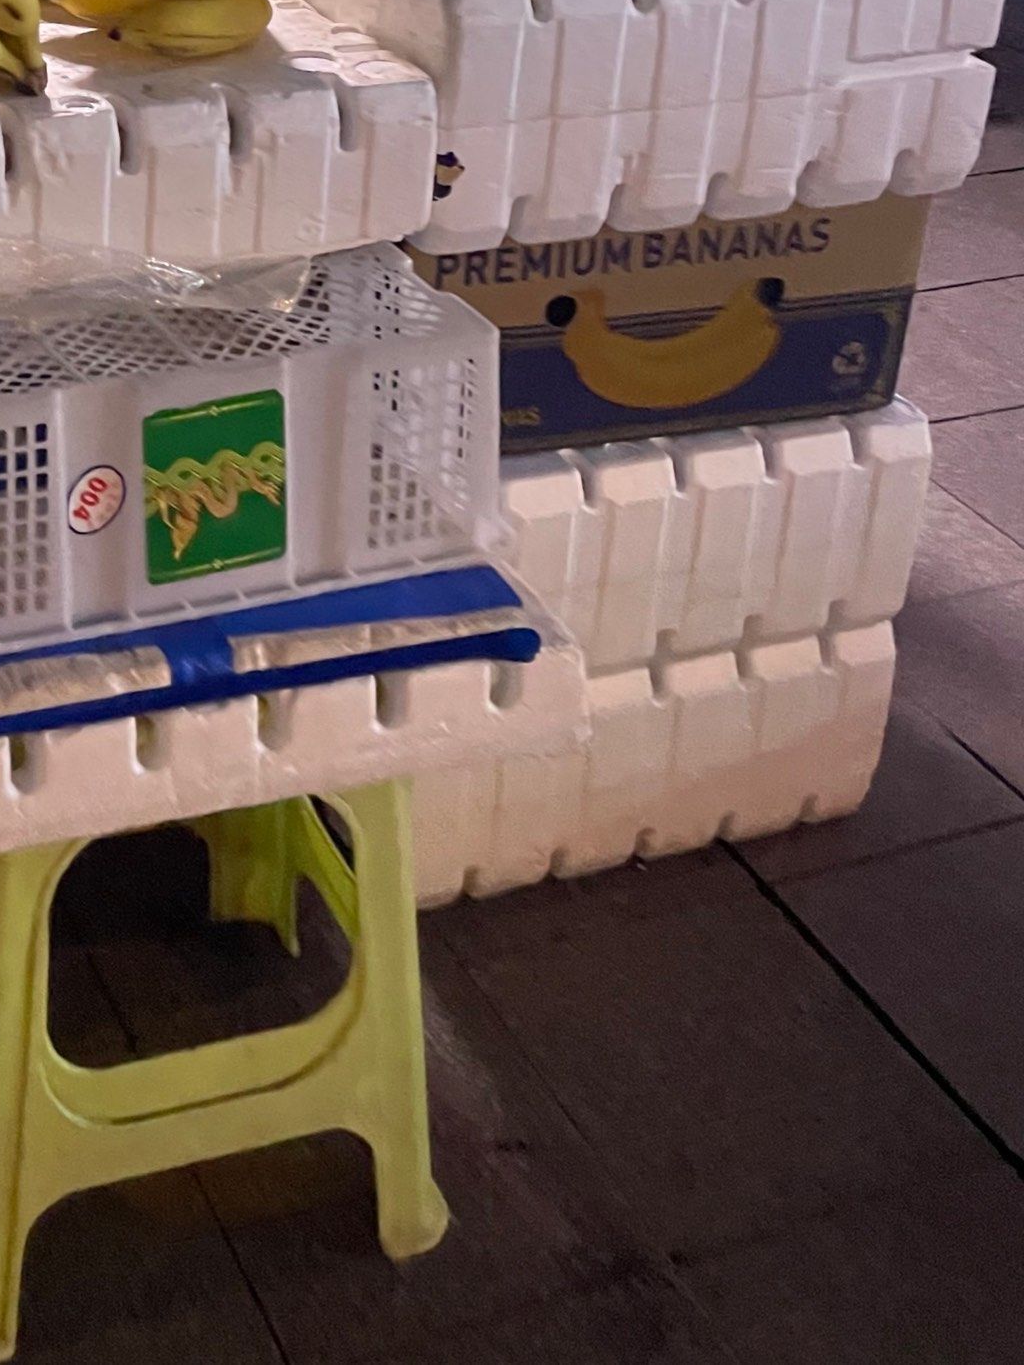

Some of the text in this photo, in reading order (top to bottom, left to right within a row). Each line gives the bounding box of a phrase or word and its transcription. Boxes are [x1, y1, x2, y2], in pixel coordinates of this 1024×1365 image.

[435, 217, 833, 288] PREMIUM BANANAS
[72, 477, 109, 521] 004
